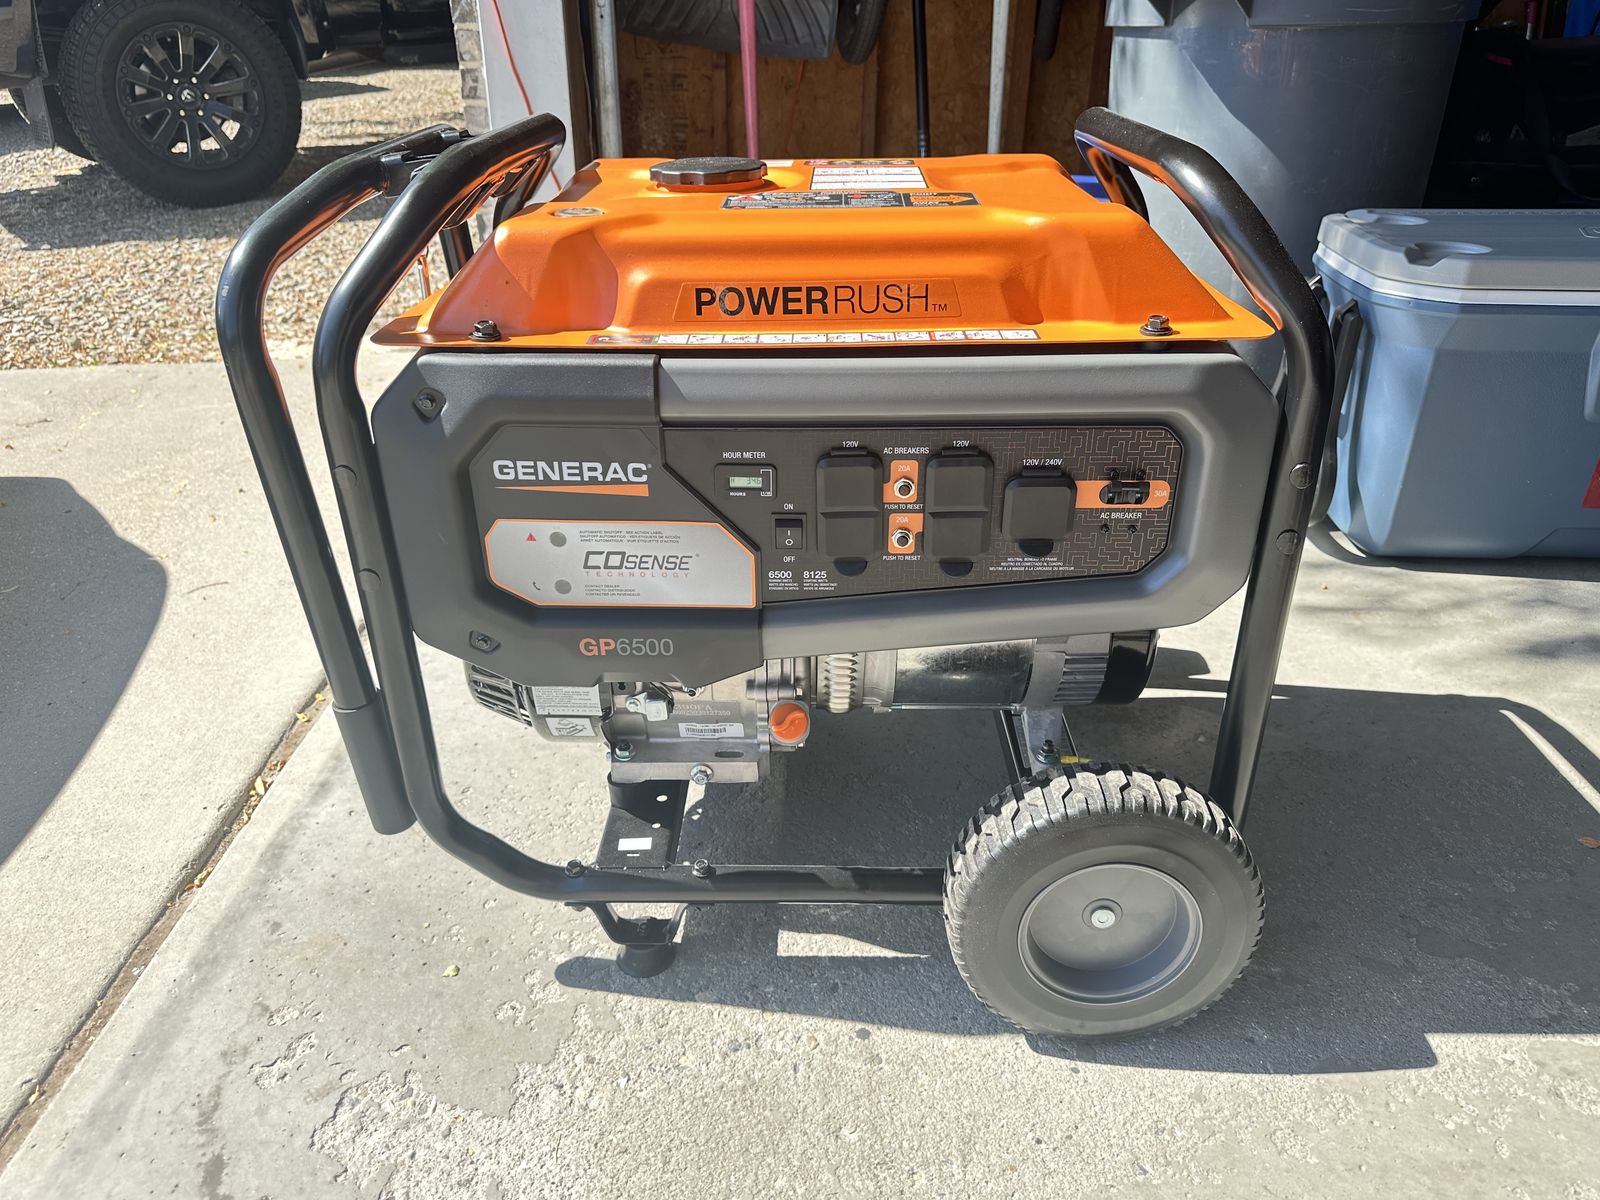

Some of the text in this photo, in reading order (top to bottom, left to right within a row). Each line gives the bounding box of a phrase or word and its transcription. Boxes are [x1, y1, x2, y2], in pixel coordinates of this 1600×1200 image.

[768, 571, 792, 579] 6500
[803, 571, 827, 579] 8125
[579, 638, 674, 656] GP6500
